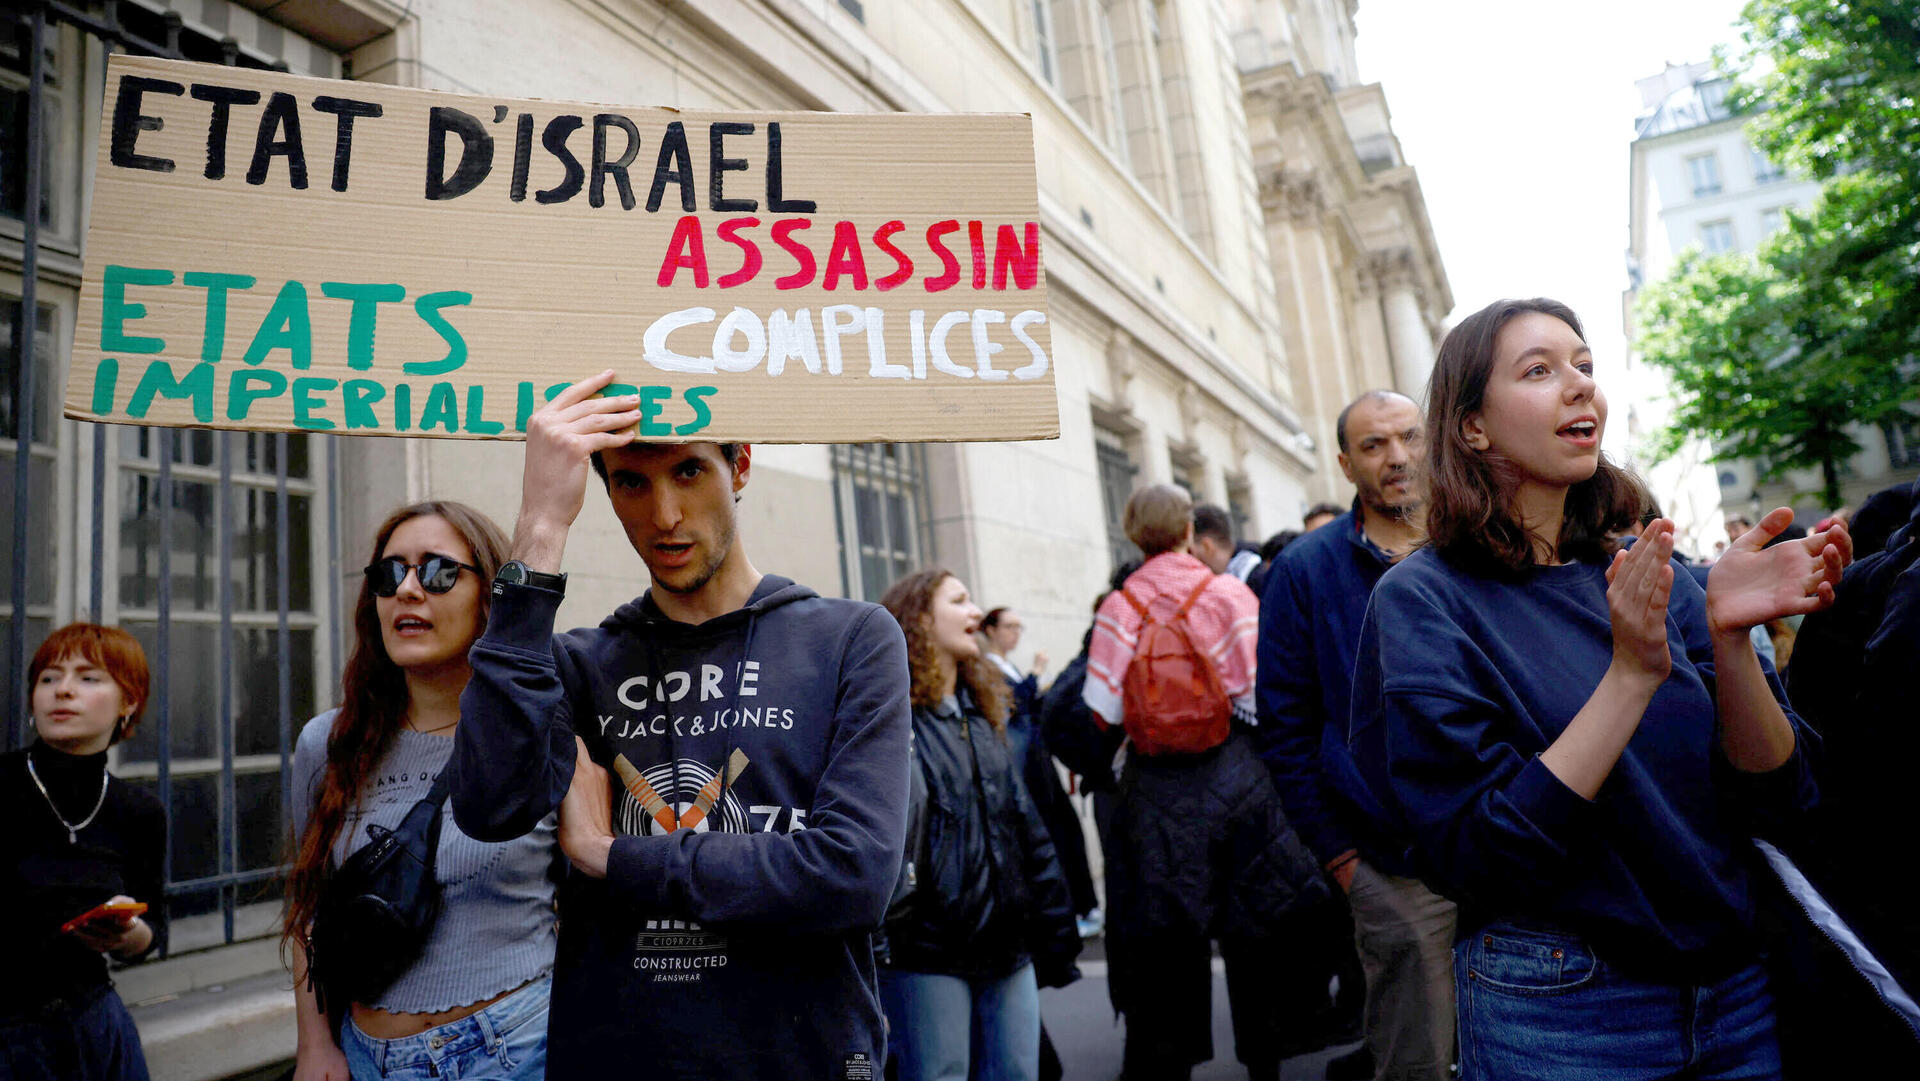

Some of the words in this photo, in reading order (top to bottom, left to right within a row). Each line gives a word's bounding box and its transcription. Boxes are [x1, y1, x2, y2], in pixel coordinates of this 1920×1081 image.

[111, 75, 383, 192] ETAT
[425, 105, 817, 213] D'ISRAEL
[657, 215, 1039, 292] ASSASSIN
[101, 265, 472, 376] ETATS
[643, 304, 1049, 381] COMPLICES
[92, 358, 719, 436] IMPERIALIES
[617, 660, 760, 710] CORE
[598, 715, 614, 736] Y
[618, 714, 684, 739] JACK
[709, 707, 795, 730] JONES
[369, 773, 408, 788] ANG
[420, 771, 440, 782] OU
[633, 955, 728, 970] CONSTRUCTED
[653, 973, 701, 982] JEANSWEAR
